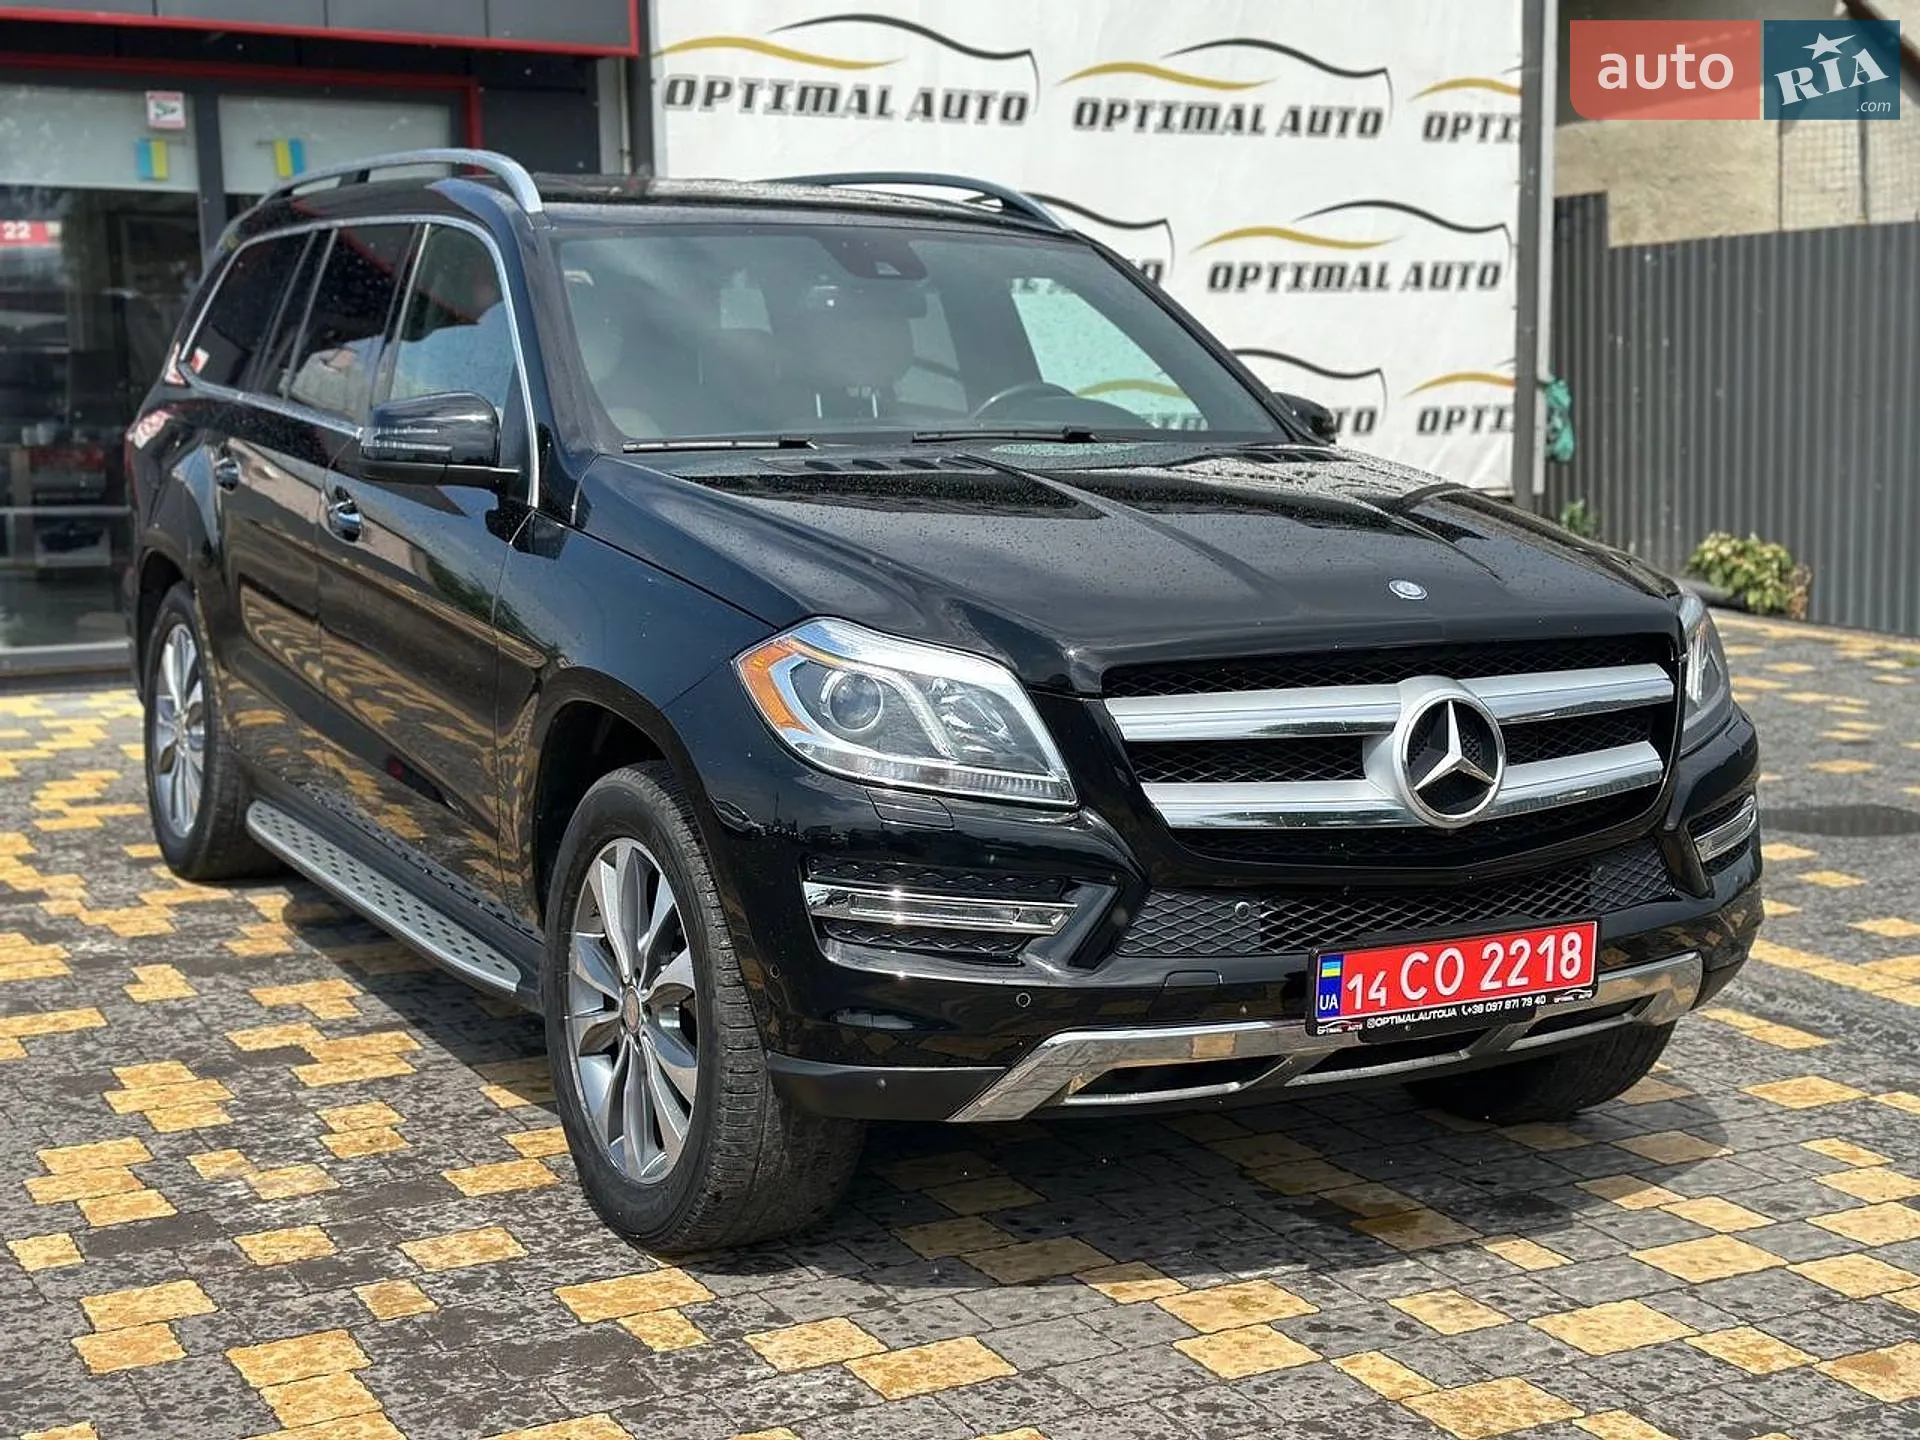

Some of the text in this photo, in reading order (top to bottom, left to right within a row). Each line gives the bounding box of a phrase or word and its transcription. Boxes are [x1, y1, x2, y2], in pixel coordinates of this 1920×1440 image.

[663, 74, 1030, 126] OPTIMAL AUTO
[1072, 97, 1384, 140] OPTIMAL AUTO
[1206, 260, 1502, 294] OPTIMAL AUTO
[1346, 931, 1582, 1009] 14 CO 2218
[1319, 994, 1339, 1010] UA
